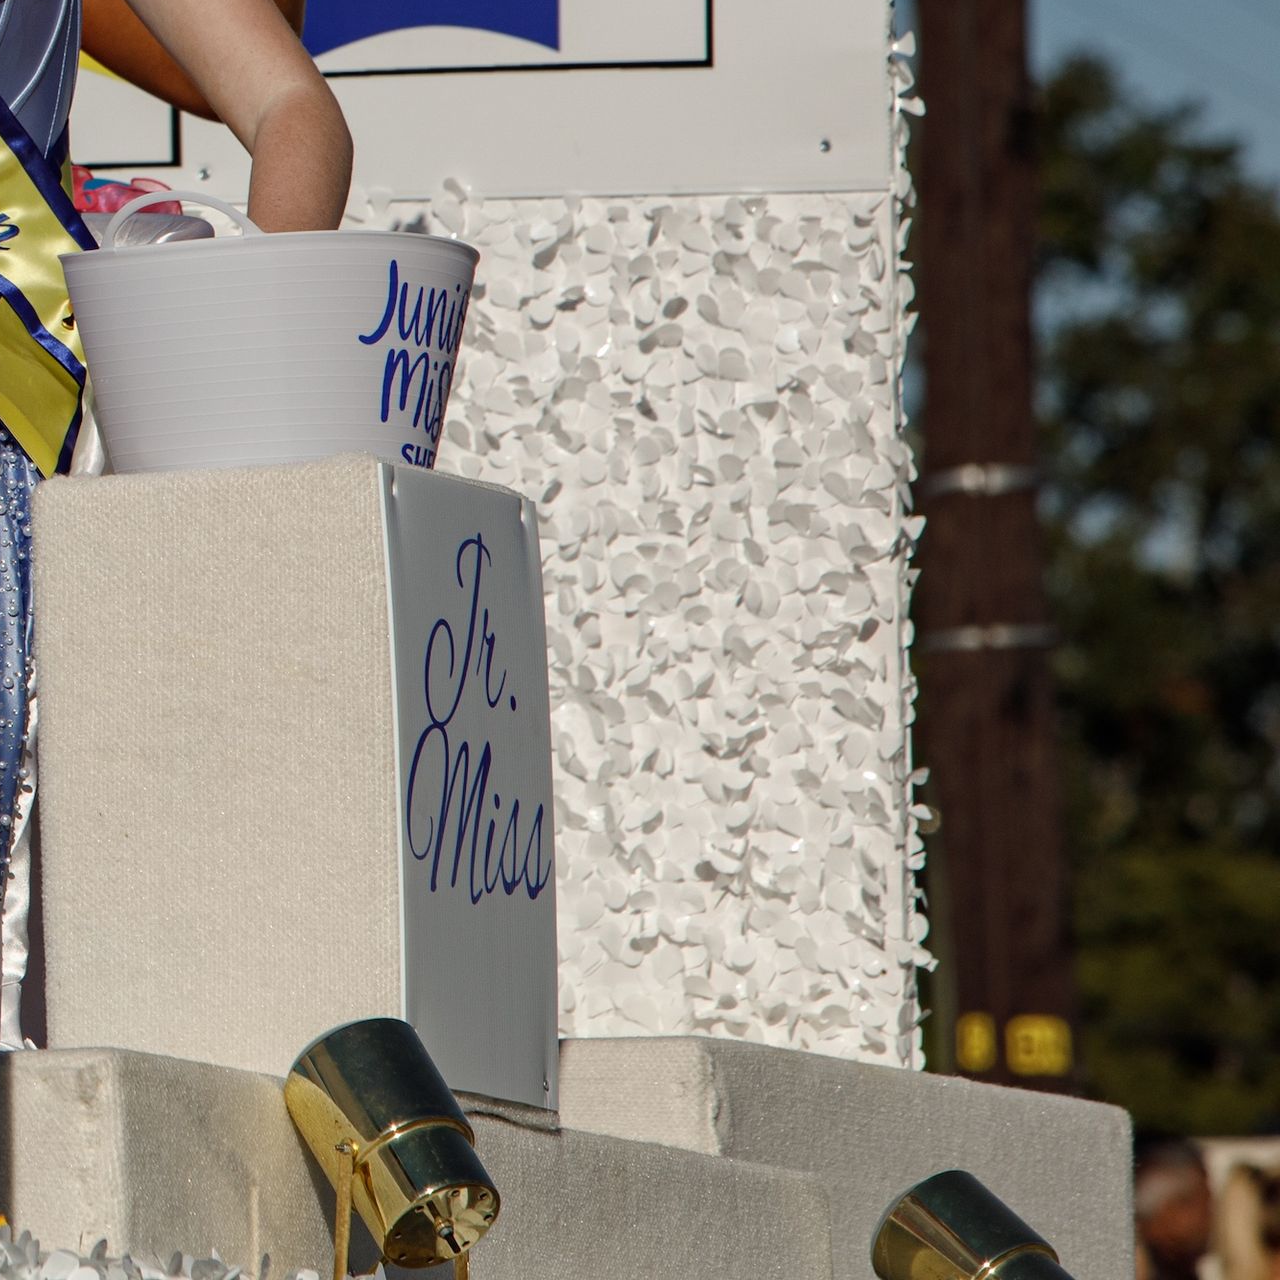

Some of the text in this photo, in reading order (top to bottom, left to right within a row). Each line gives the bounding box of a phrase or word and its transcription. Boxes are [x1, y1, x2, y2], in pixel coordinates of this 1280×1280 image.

[380, 347, 452, 444] Mis
[424, 531, 517, 728] Jr.
[406, 722, 552, 906] Miss
